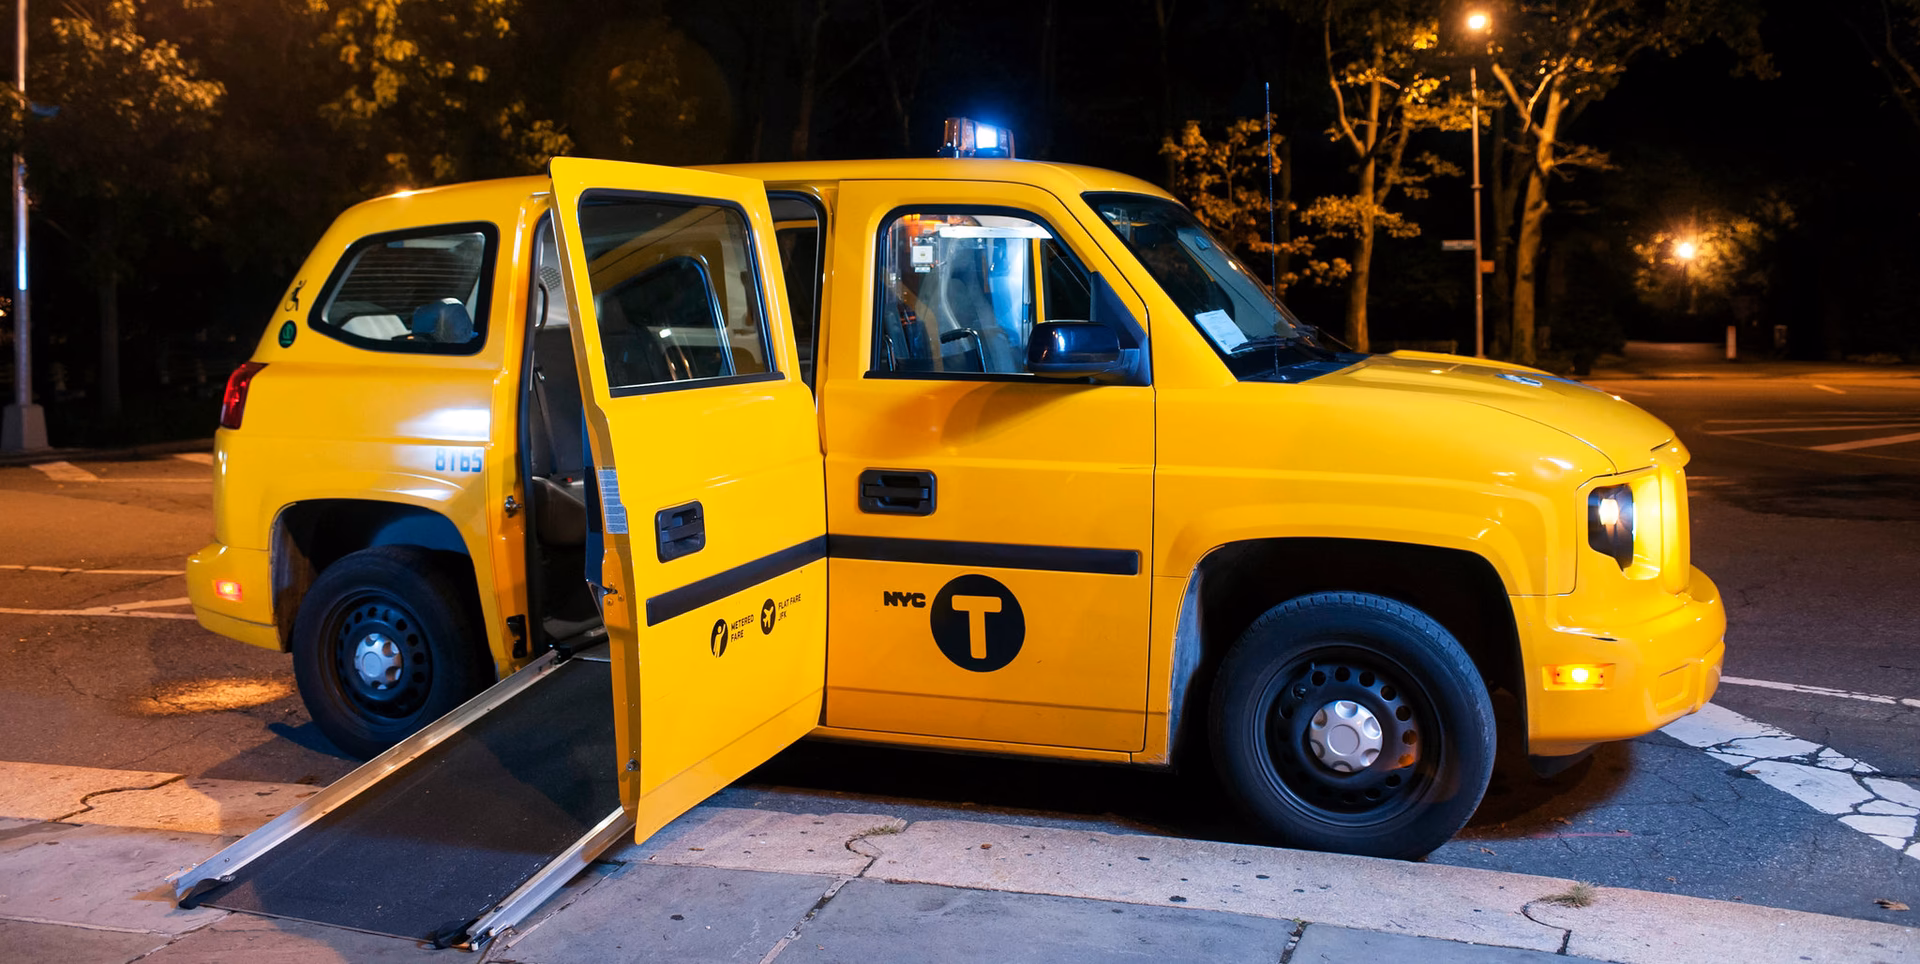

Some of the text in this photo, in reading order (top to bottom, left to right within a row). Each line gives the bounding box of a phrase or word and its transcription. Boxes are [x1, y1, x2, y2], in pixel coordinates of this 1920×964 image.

[435, 448, 482, 472] 8165
[778, 593, 801, 610] FLAT FARE
[731, 614, 754, 631] METERED
[778, 611, 787, 621] JFK
[884, 591, 1002, 659] NYC T
[731, 629, 744, 642] FARE
